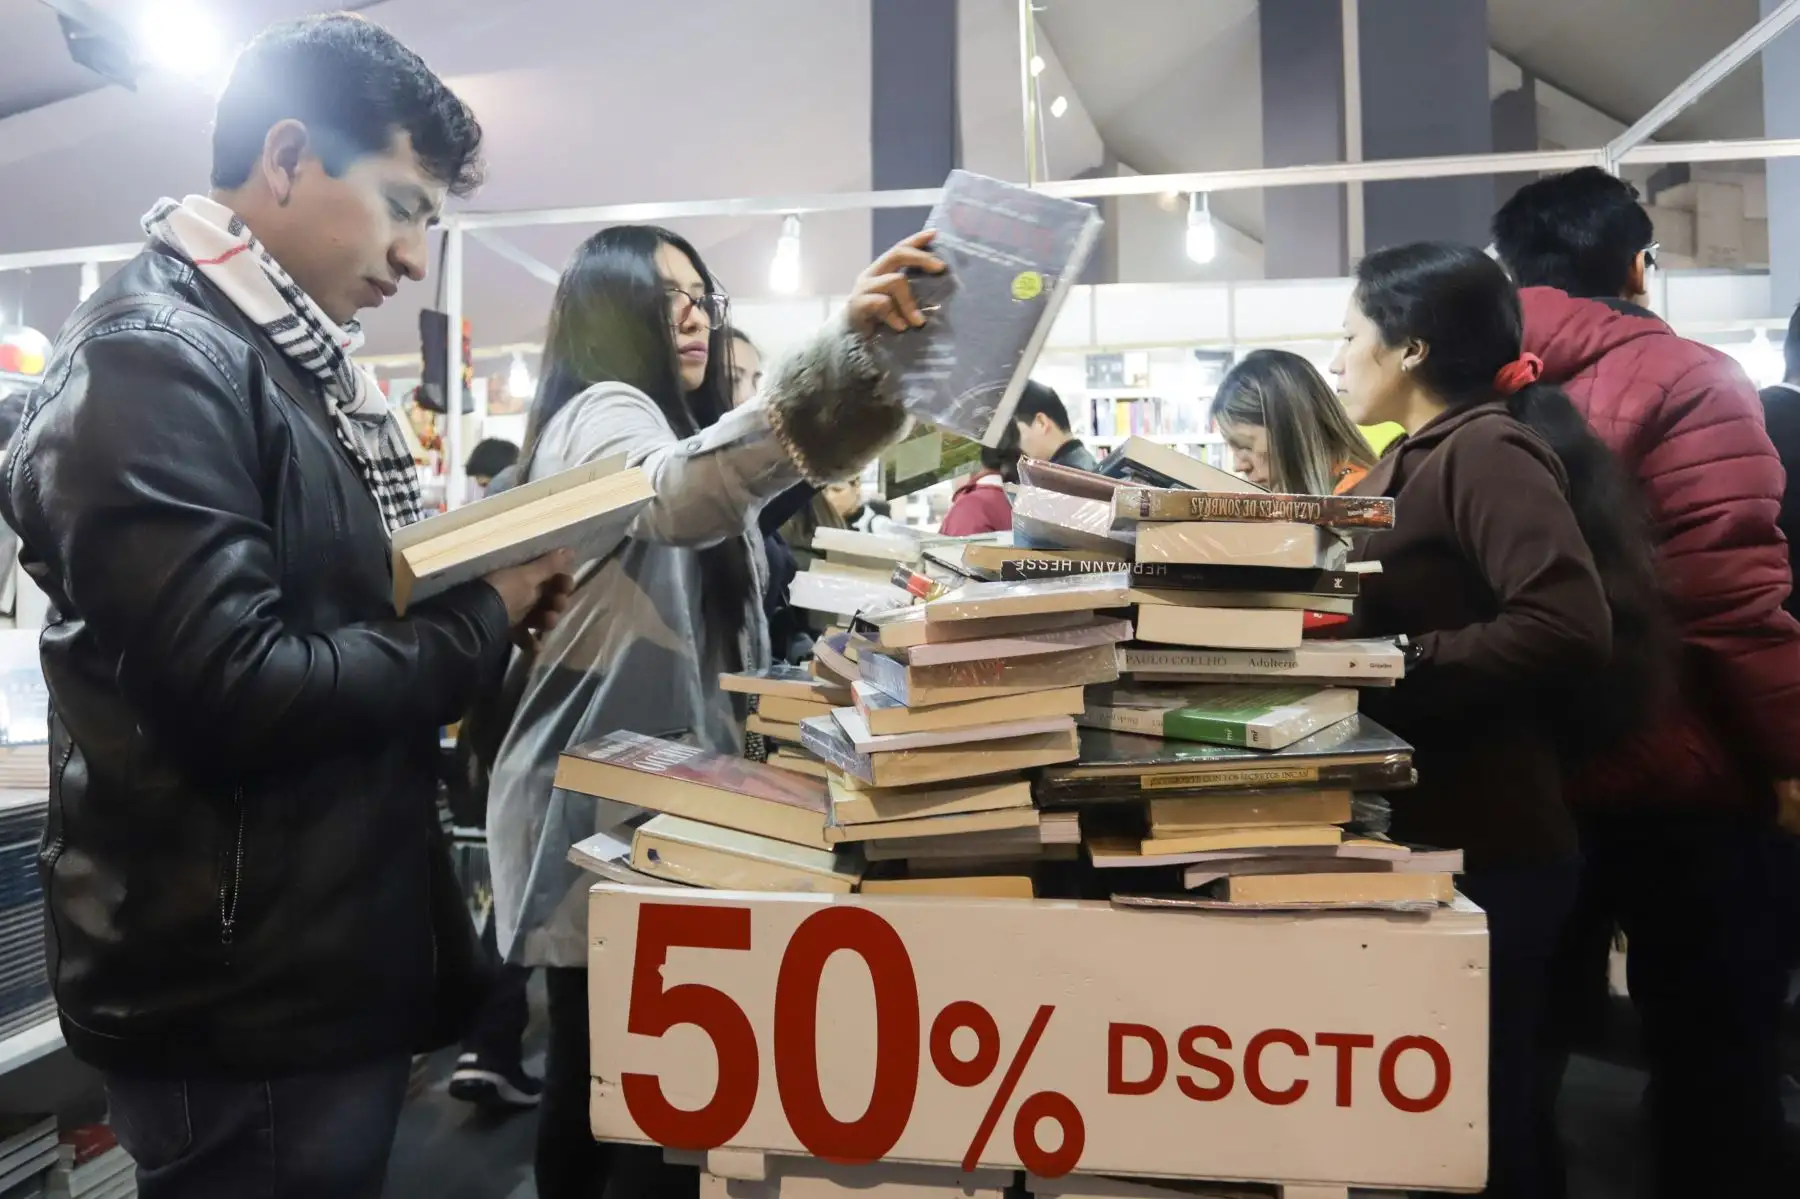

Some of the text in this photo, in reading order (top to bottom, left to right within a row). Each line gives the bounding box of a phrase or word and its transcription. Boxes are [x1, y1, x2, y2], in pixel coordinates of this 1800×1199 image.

[1242, 497, 1257, 518] DE
[1259, 498, 1321, 521] CAZADORES
[1015, 559, 1072, 572] HESSE
[1079, 559, 1168, 577] HERMANN
[1125, 654, 1227, 667] PAULO COELHO
[1107, 1022, 1452, 1113] DSCTO
